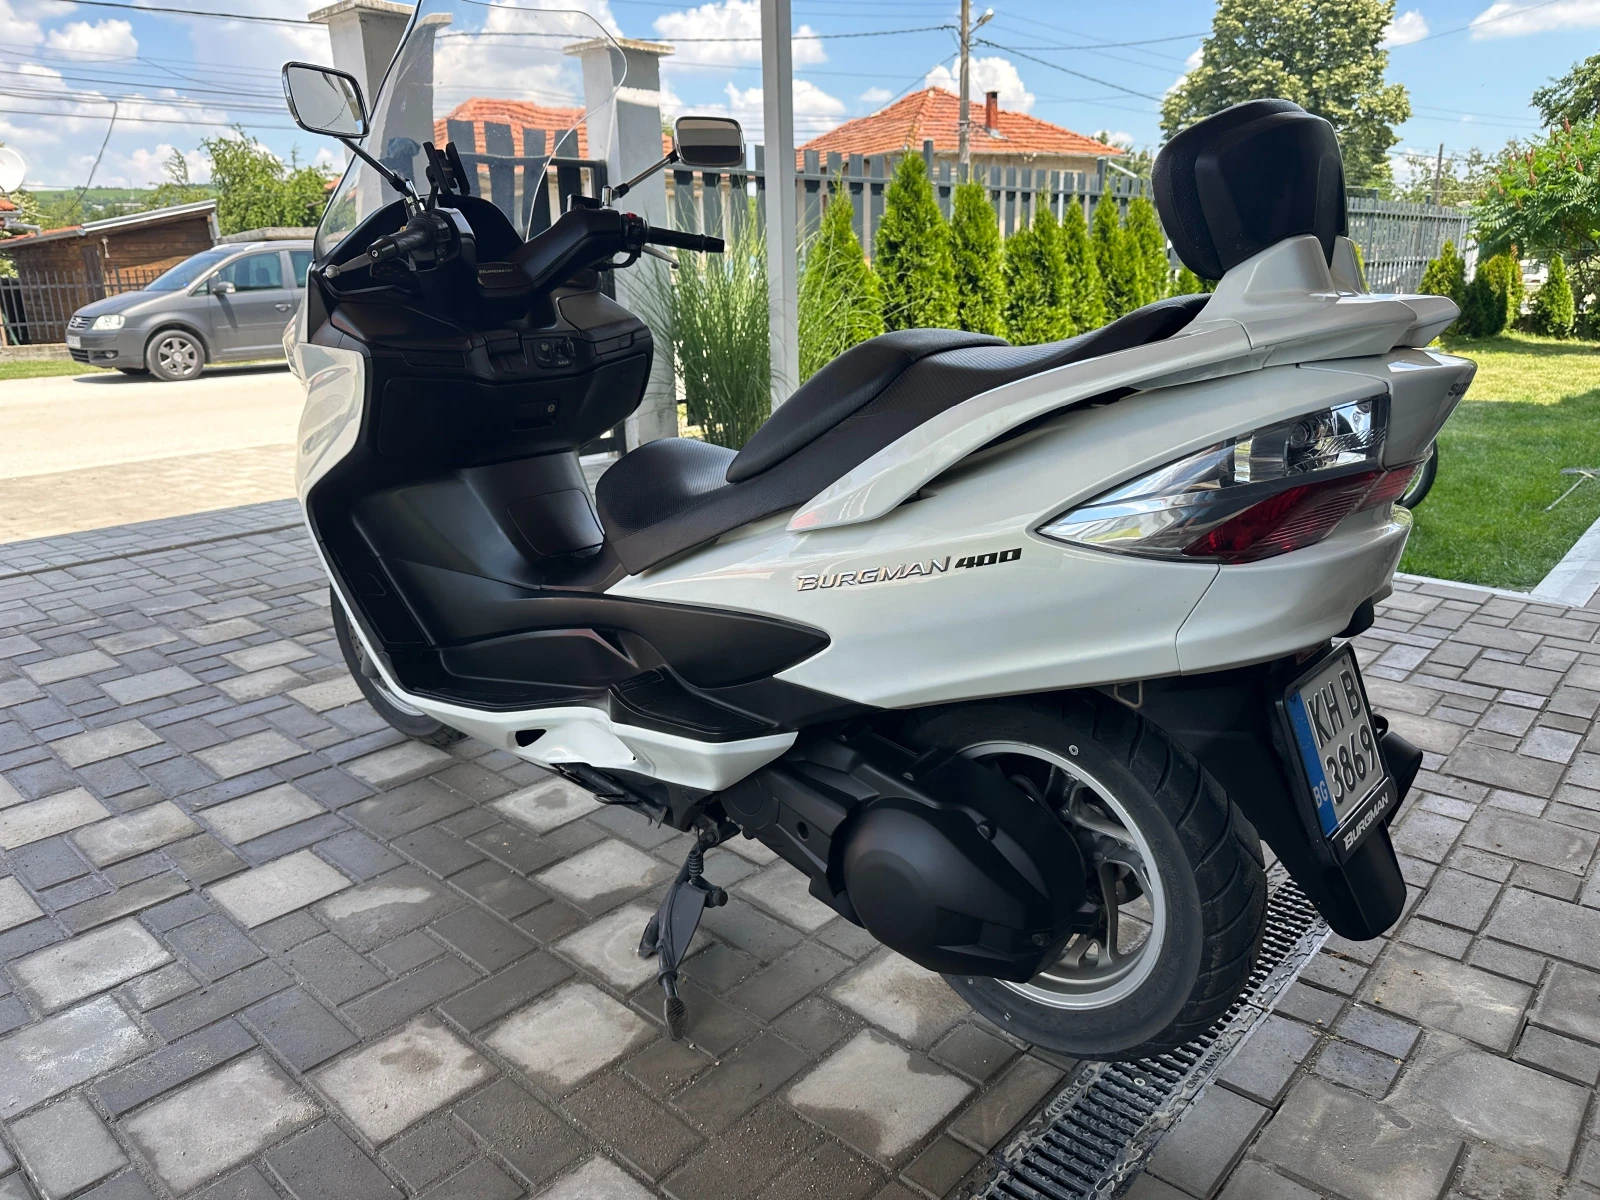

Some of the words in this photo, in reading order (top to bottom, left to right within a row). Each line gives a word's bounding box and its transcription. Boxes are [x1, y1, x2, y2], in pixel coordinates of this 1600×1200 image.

[796, 555, 951, 591] BURGMAN
[954, 547, 1022, 569] 400
[1324, 723, 1376, 806] 3869
[1312, 779, 1329, 809] BG
[1343, 791, 1389, 851] BURGMAN
